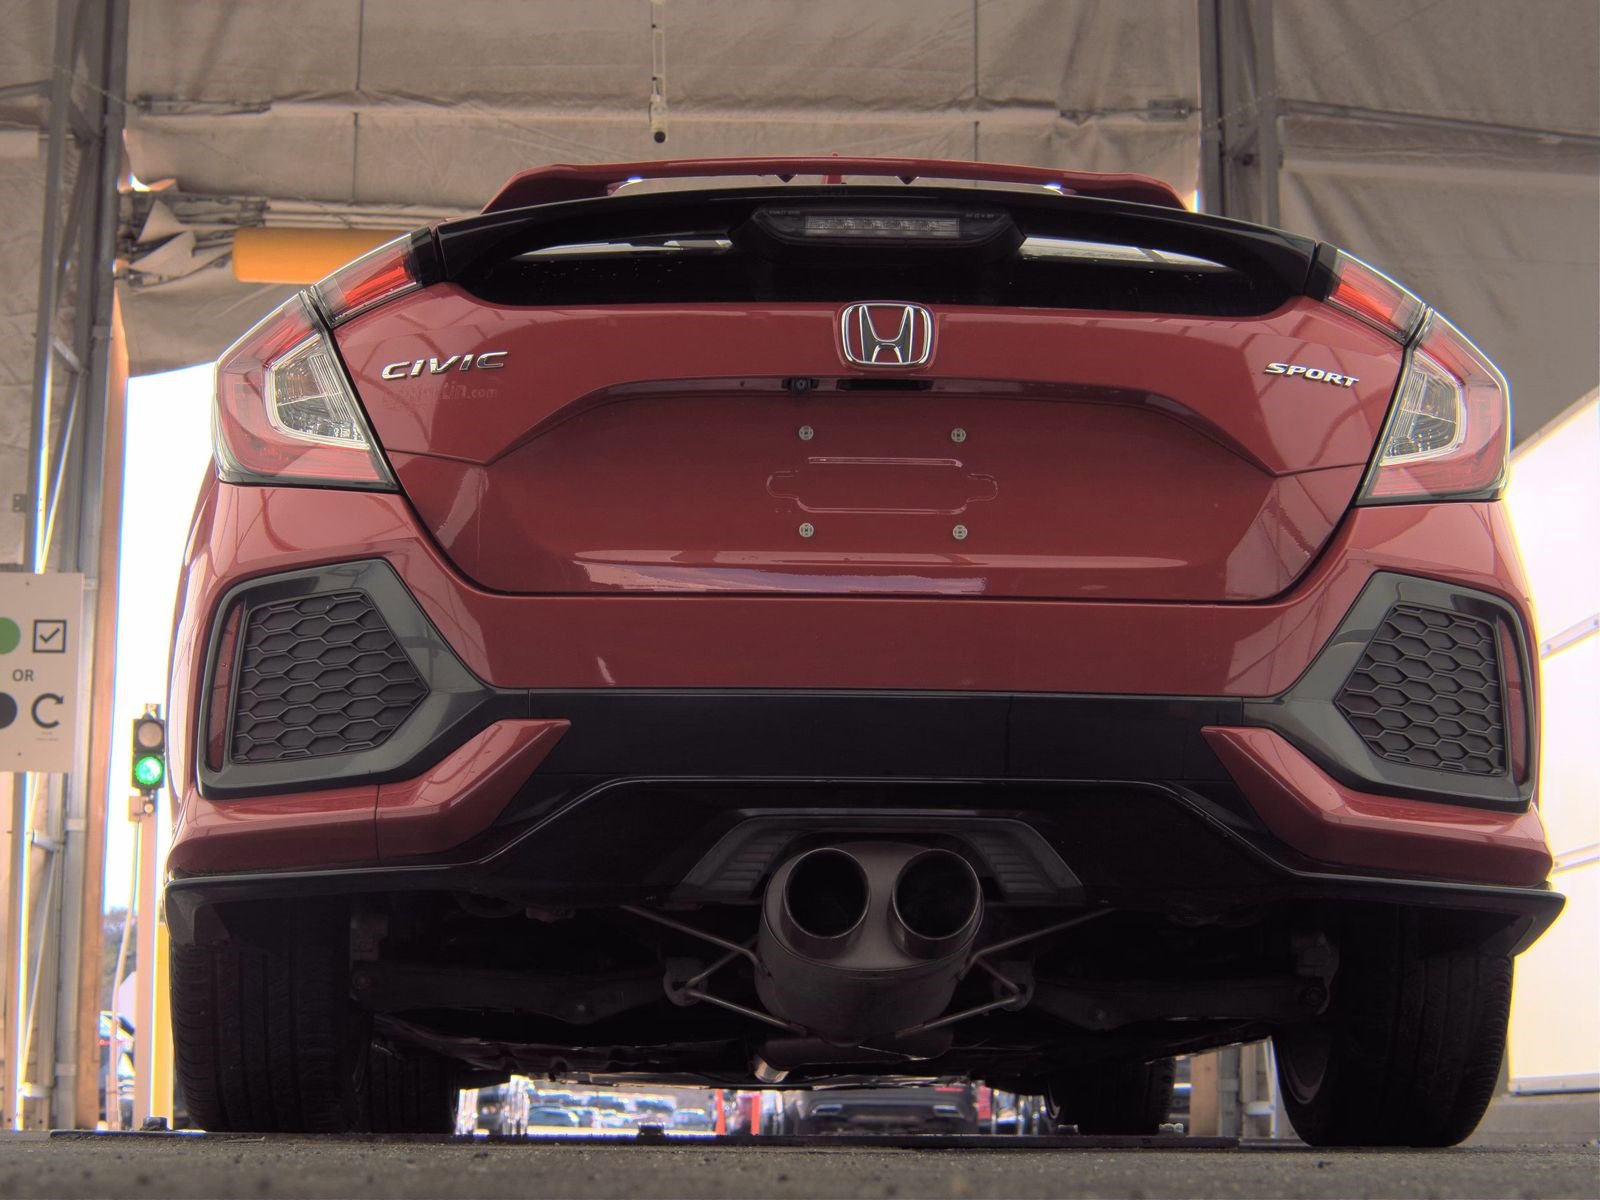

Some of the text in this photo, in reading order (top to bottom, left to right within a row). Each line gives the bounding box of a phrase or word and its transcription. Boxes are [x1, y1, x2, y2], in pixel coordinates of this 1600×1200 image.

[381, 351, 508, 380] CIVIC
[1264, 362, 1360, 388] SPORT
[12, 669, 34, 682] OR
